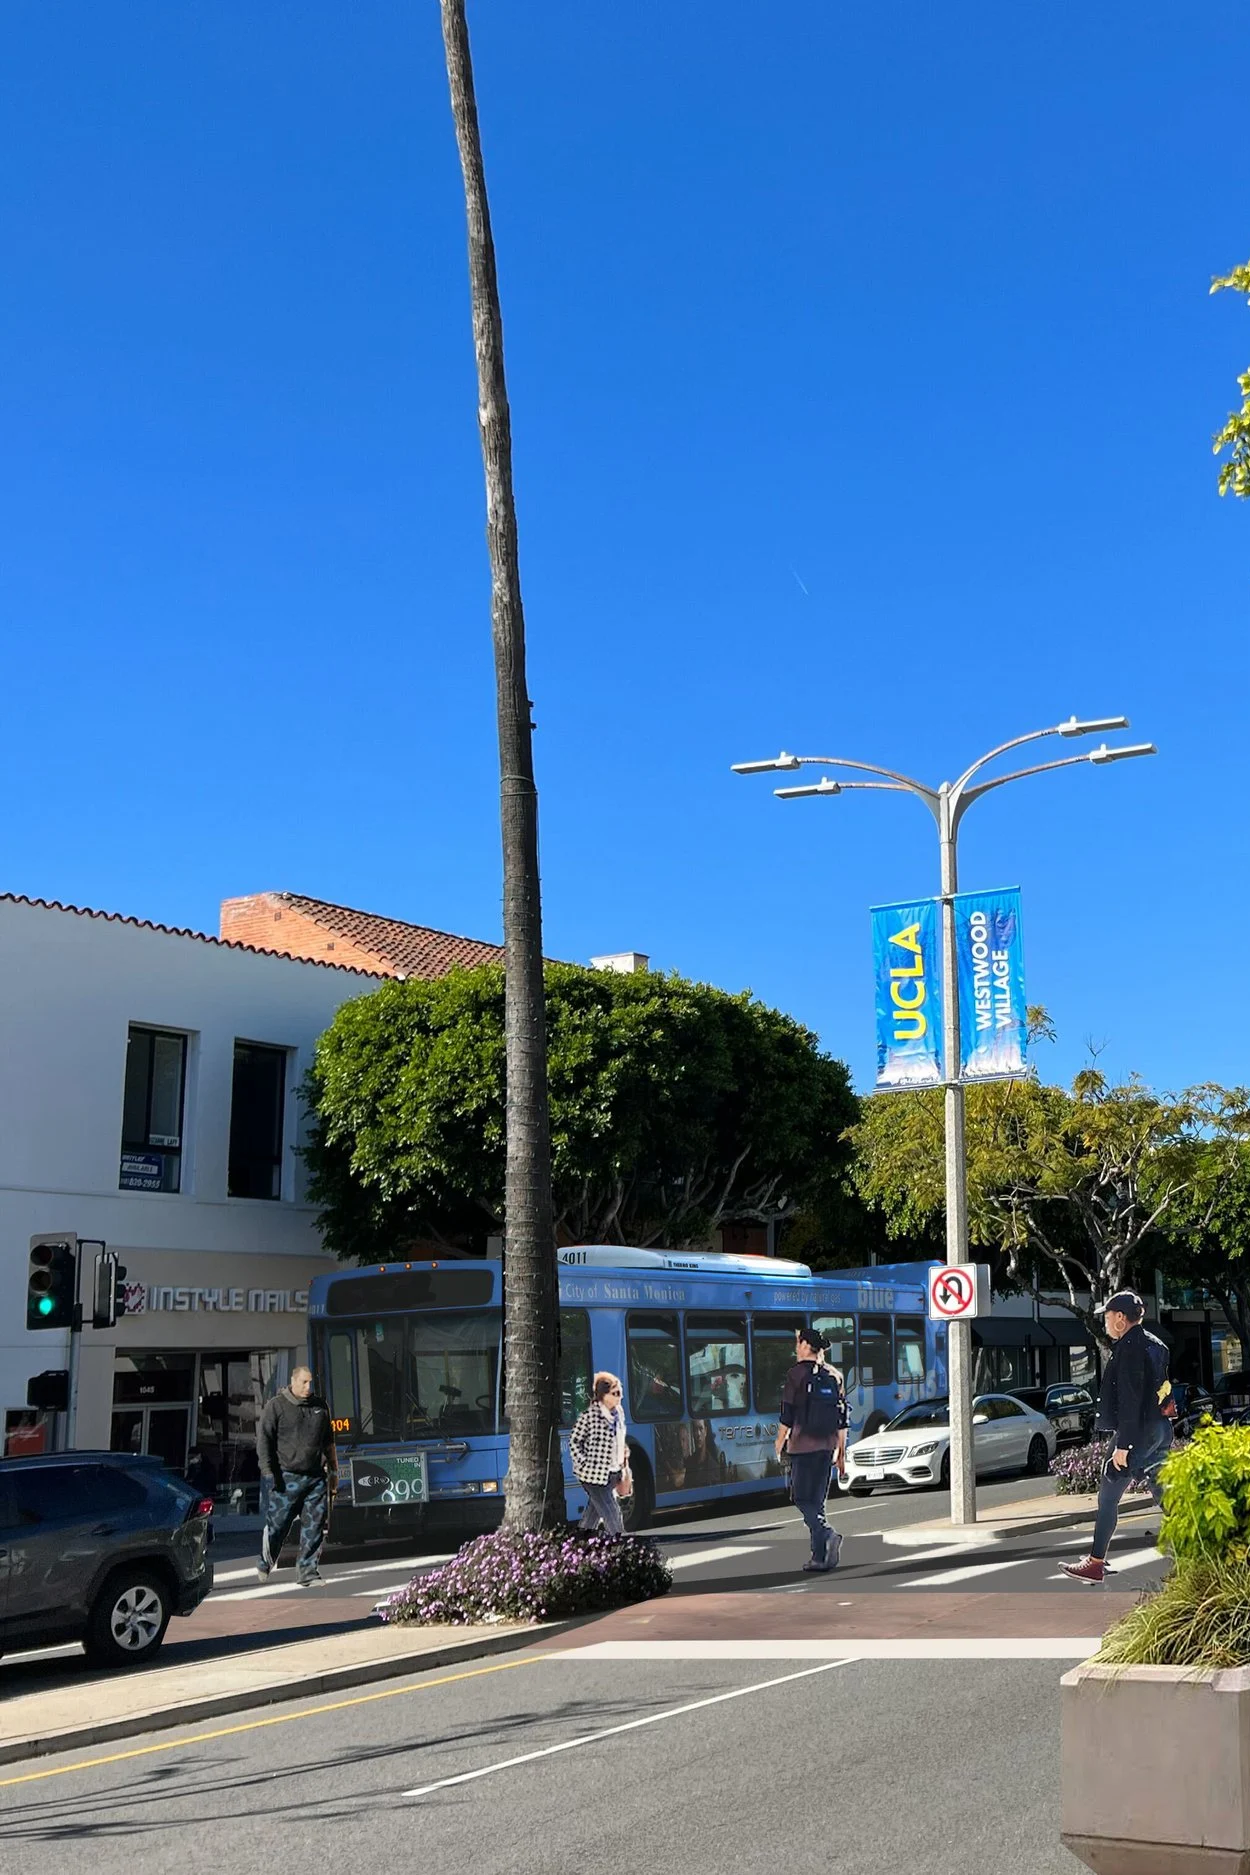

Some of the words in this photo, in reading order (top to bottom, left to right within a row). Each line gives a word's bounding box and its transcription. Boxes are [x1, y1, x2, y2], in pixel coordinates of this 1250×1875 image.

[888, 922, 927, 1040] UCLA
[969, 911, 992, 1031] WESTWOOD
[992, 949, 1012, 1028] VILLAGE
[562, 1252, 587, 1265] 4011
[150, 1287, 244, 1312] INSTYLE
[248, 1289, 308, 1312] NAILS
[565, 1283, 584, 1301] City
[587, 1283, 598, 1298] of
[604, 1283, 639, 1300] Santa
[644, 1285, 685, 1301] Monica
[857, 1281, 895, 1309] blue
[139, 1385, 155, 1394] 1045
